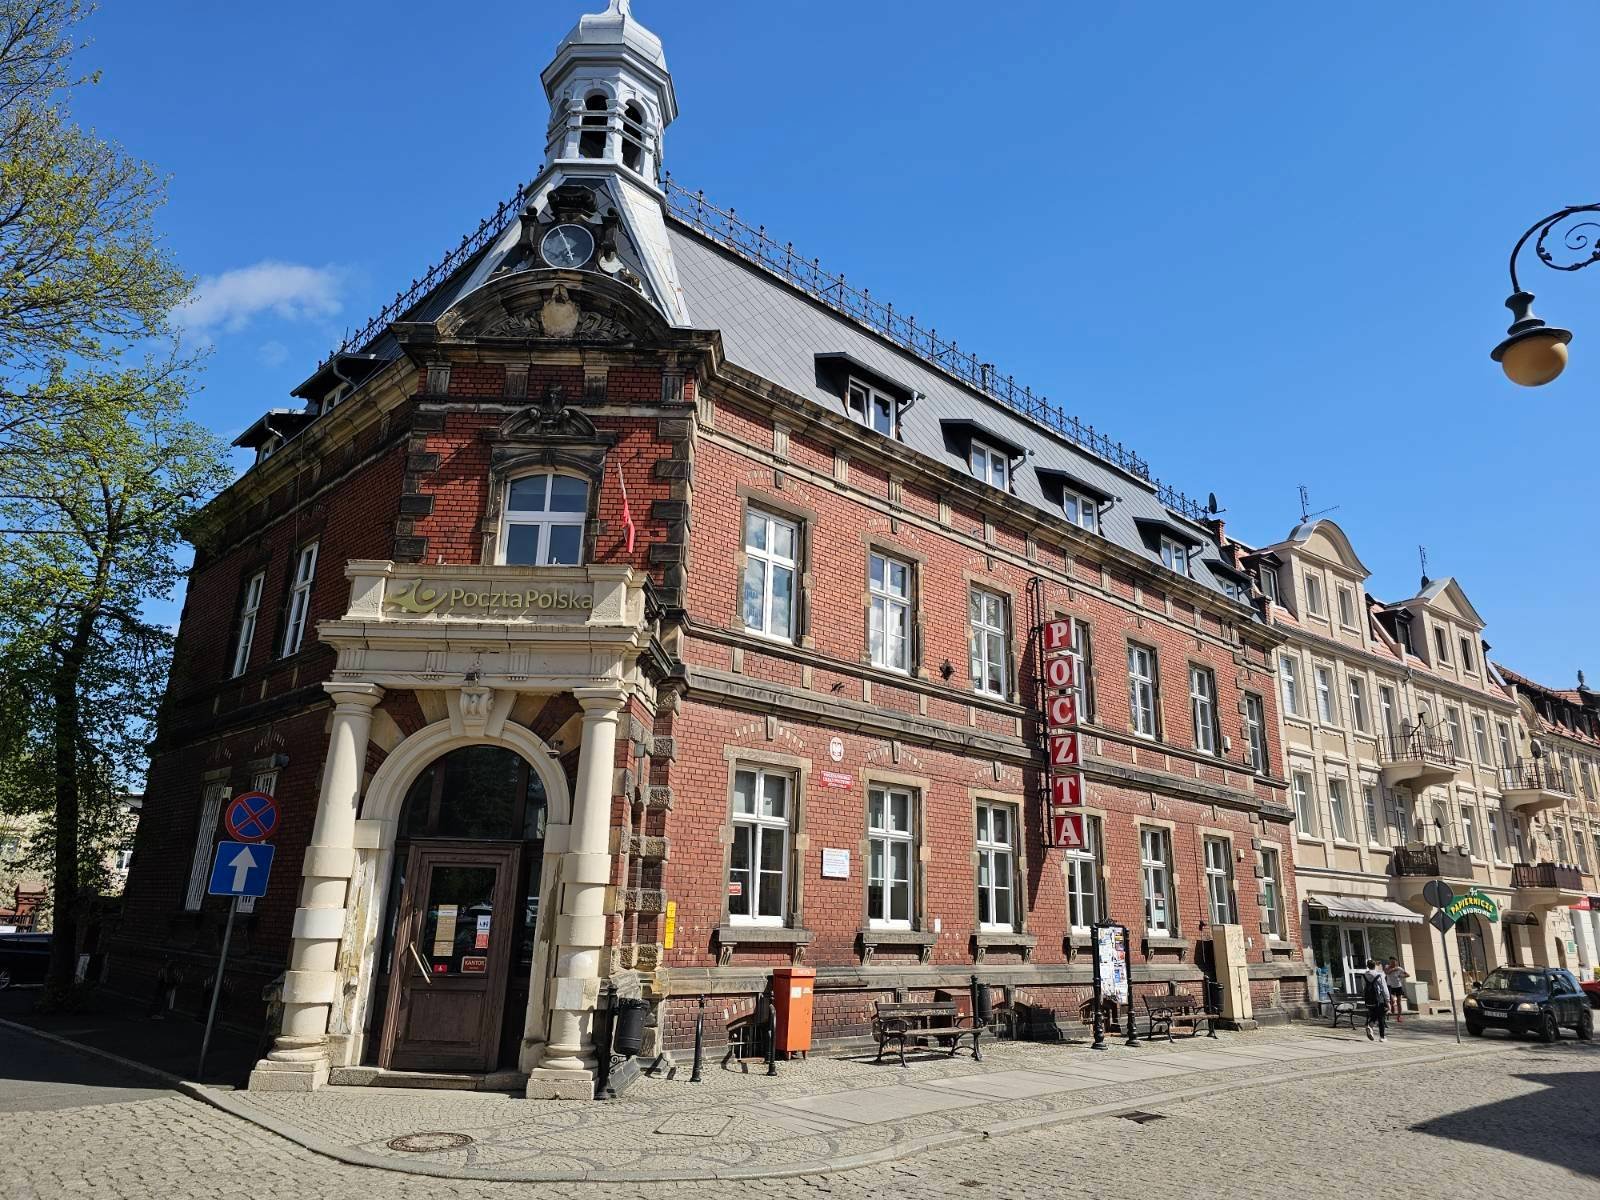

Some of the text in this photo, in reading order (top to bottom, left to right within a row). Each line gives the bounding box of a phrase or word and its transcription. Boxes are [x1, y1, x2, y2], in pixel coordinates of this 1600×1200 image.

[450, 586, 593, 609] Poczta Polska
[1050, 621, 1081, 846] POCZTA
[1450, 897, 1494, 916] PAPIERNICZE
